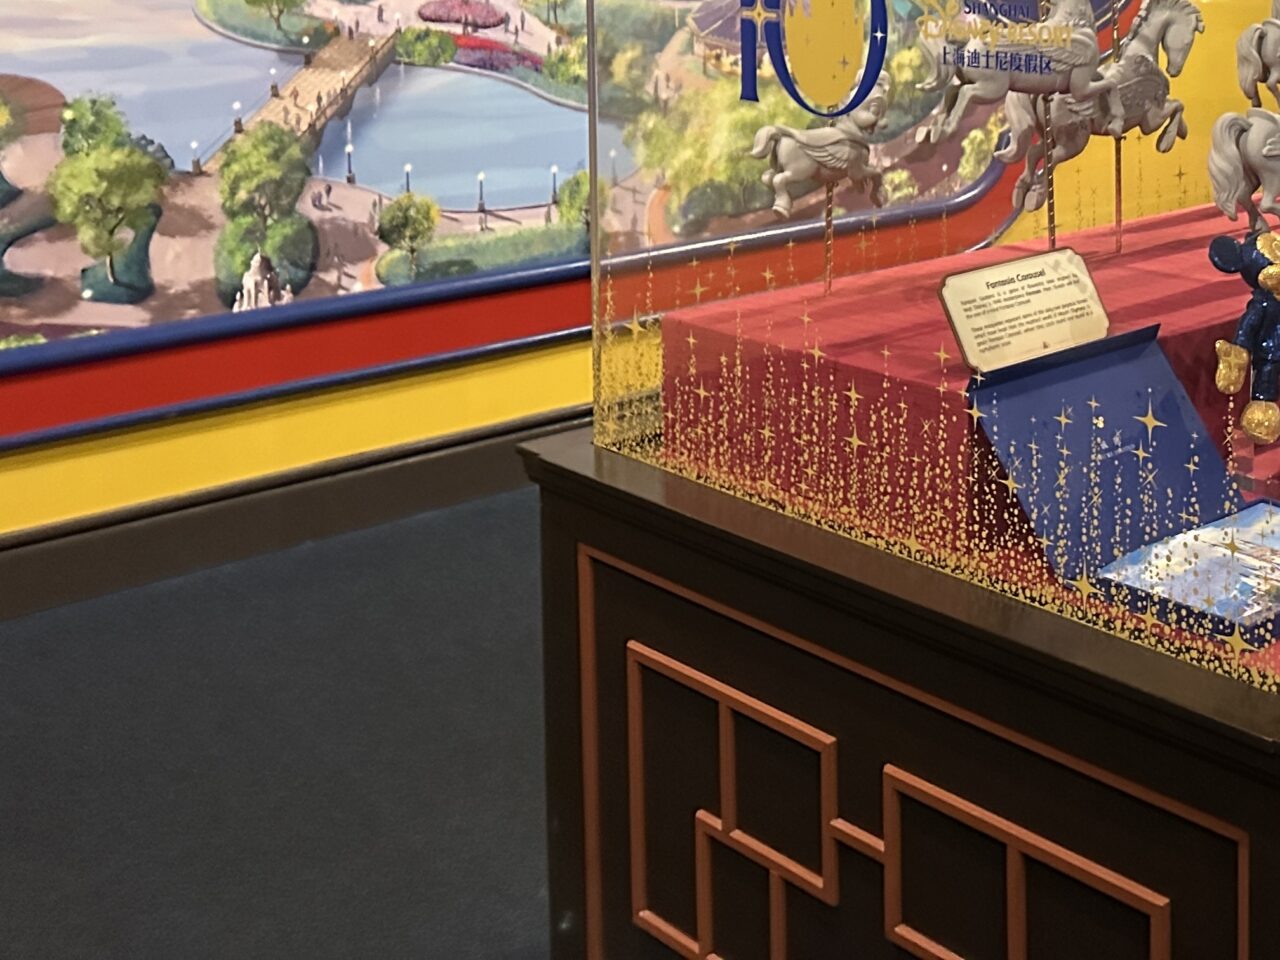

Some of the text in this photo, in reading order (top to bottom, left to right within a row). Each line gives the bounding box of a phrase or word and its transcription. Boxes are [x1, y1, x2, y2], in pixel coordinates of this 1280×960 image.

[942, 46, 1054, 75] 上海迪士尼度假区
[985, 268, 1046, 290] Fantasia Carousel
